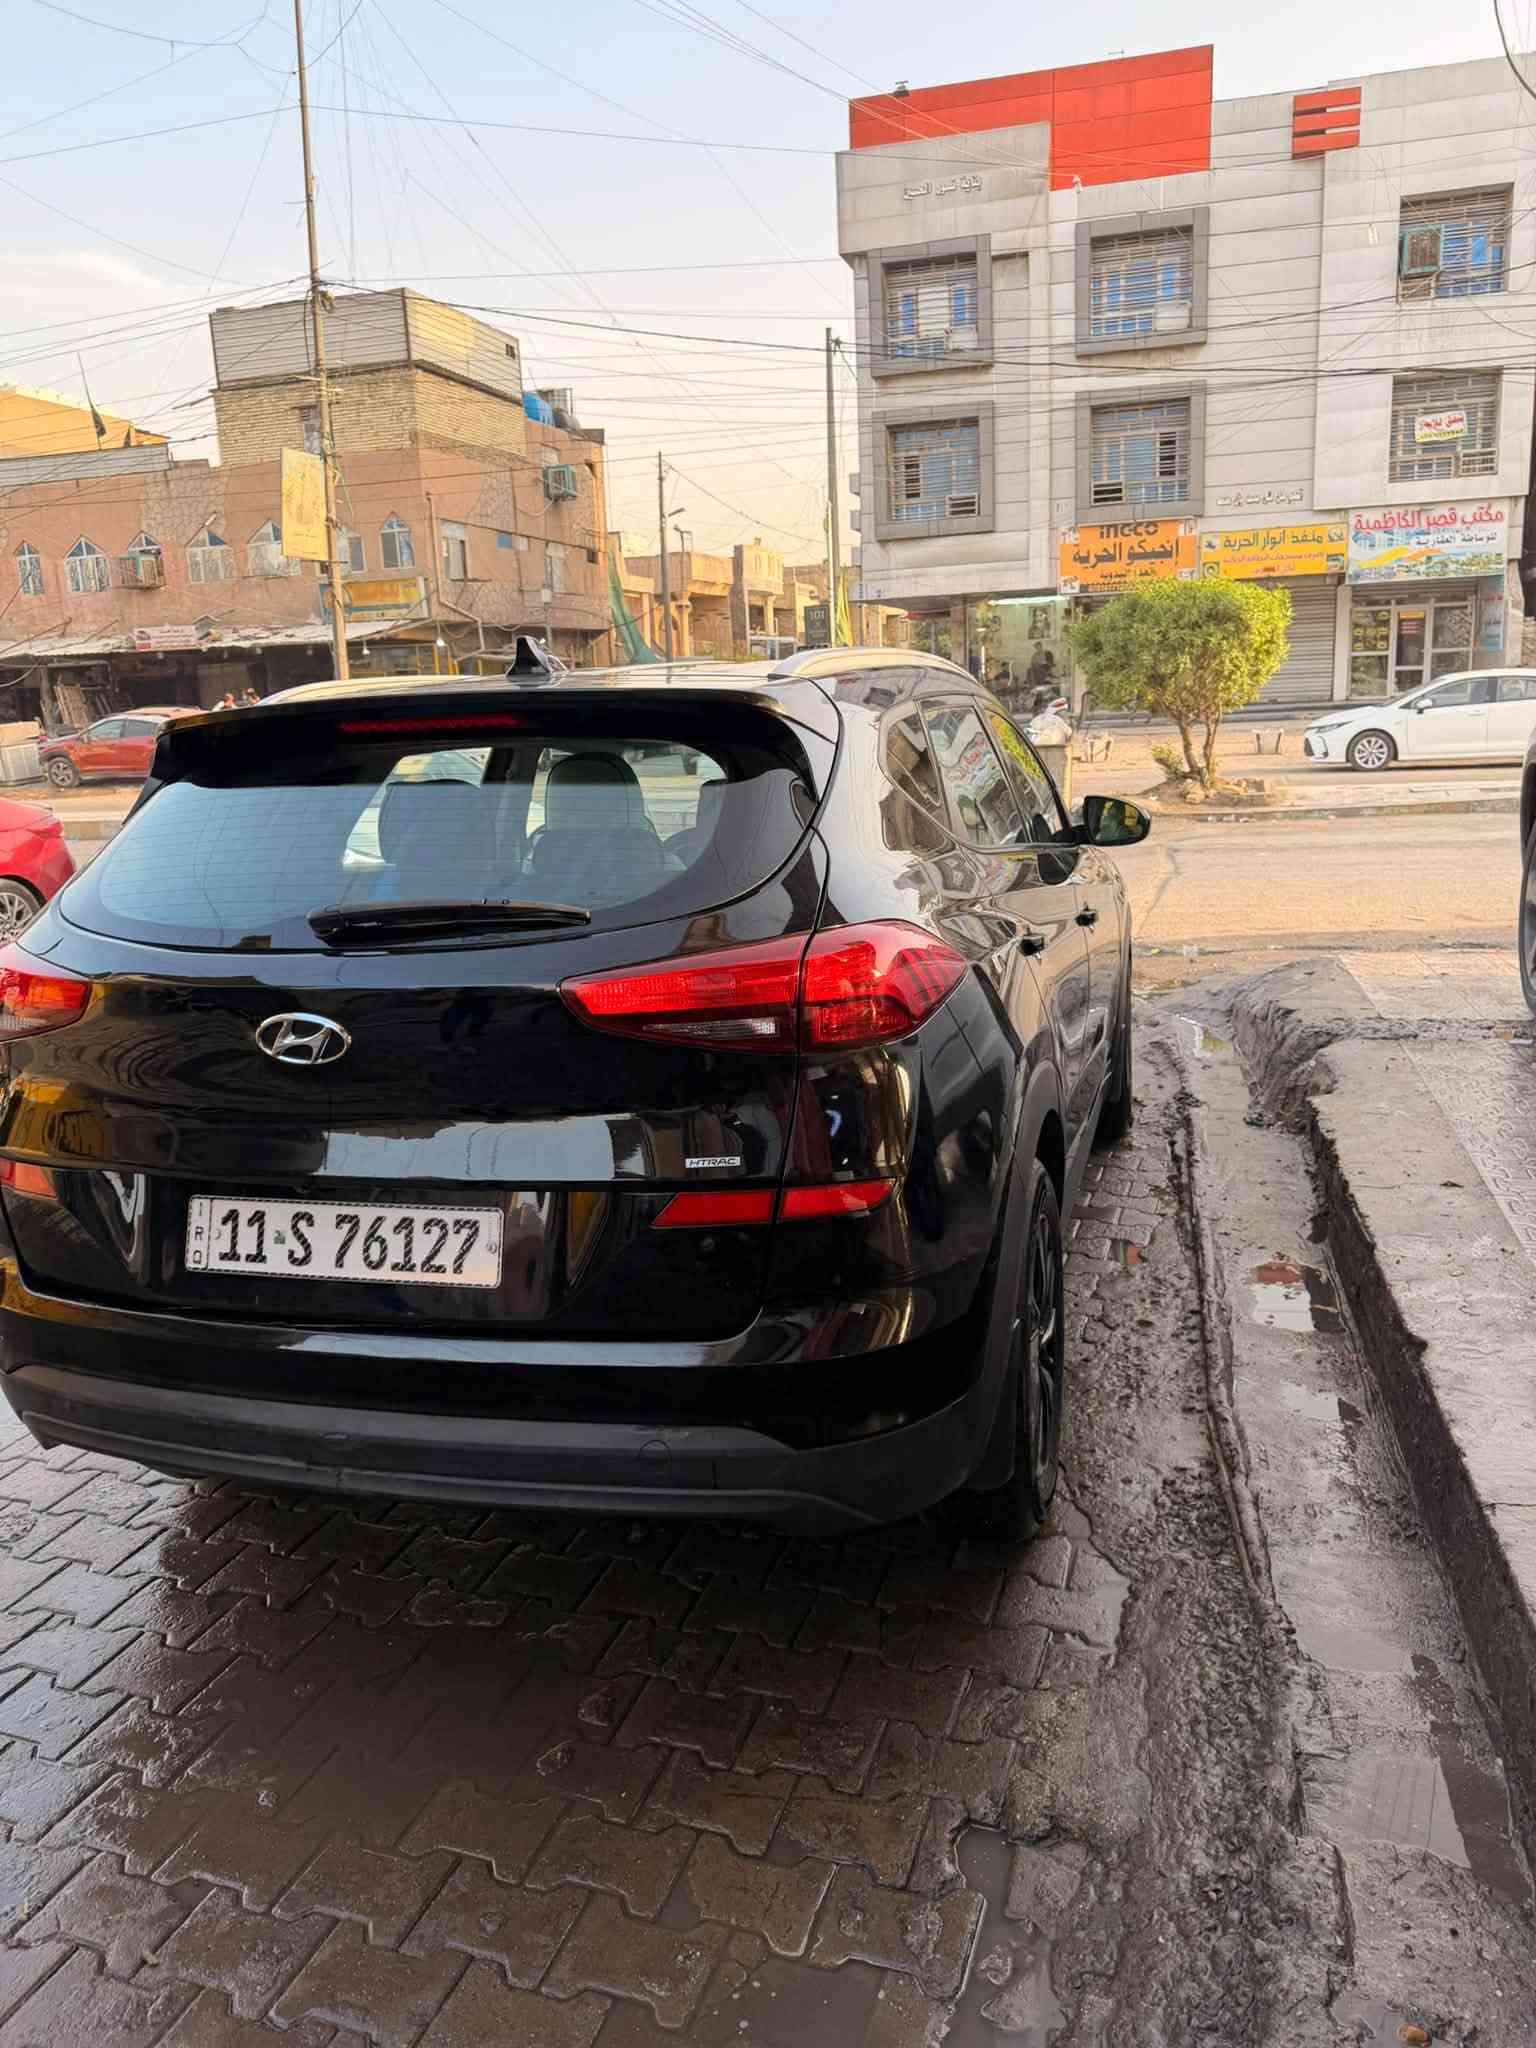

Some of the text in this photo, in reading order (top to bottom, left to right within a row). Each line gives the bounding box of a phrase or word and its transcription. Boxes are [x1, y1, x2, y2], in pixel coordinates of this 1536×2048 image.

[1354, 502, 1504, 534] مكتب قصر الكاظمية
[1072, 541, 1123, 569] الحرية
[1222, 531, 1260, 552] الحرية
[688, 1157, 739, 1167] HTRAC
[218, 1209, 268, 1264] 11
[287, 1211, 315, 1267] S
[335, 1213, 480, 1275] 76127
